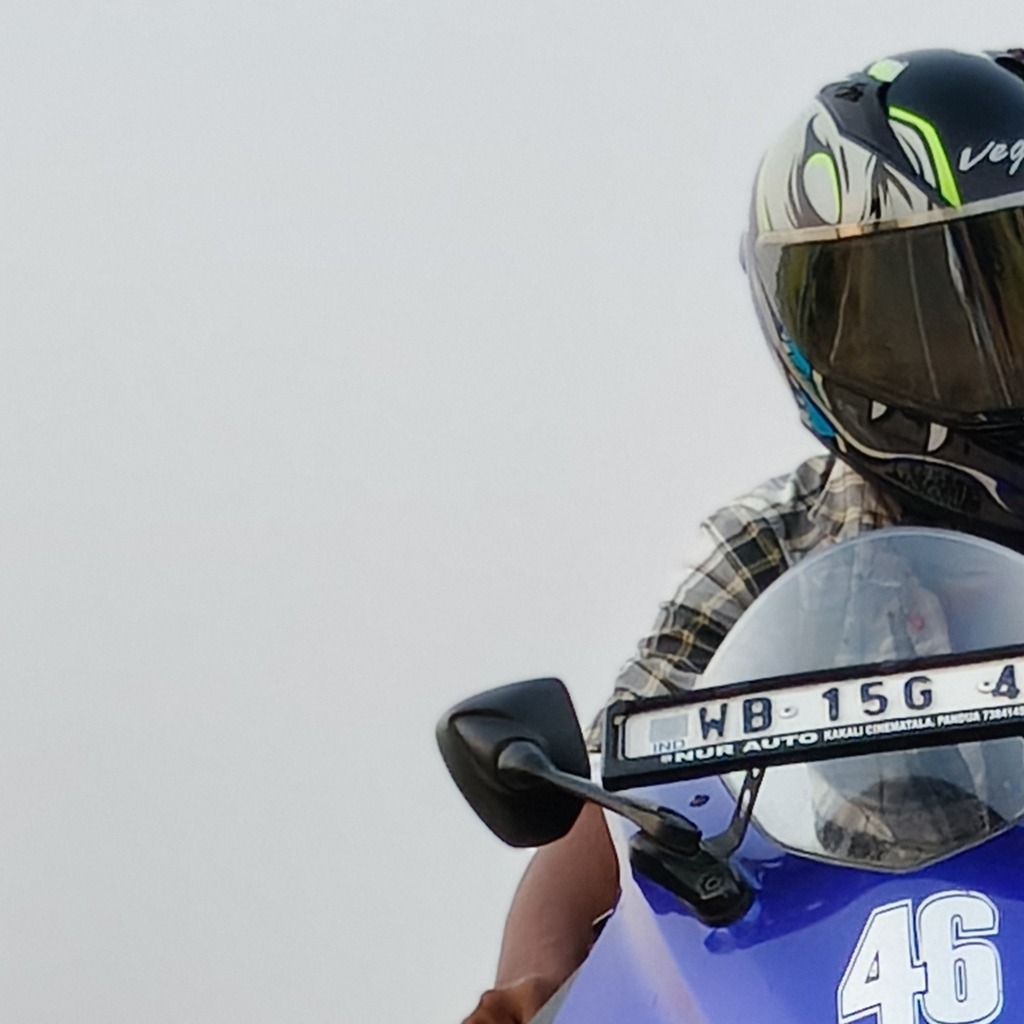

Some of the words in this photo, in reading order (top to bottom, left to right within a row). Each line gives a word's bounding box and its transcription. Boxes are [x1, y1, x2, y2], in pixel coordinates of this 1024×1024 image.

[699, 696, 773, 740] WB
[822, 676, 933, 721] 15G
[653, 739, 685, 753] IND
[742, 732, 818, 754] AUTO
